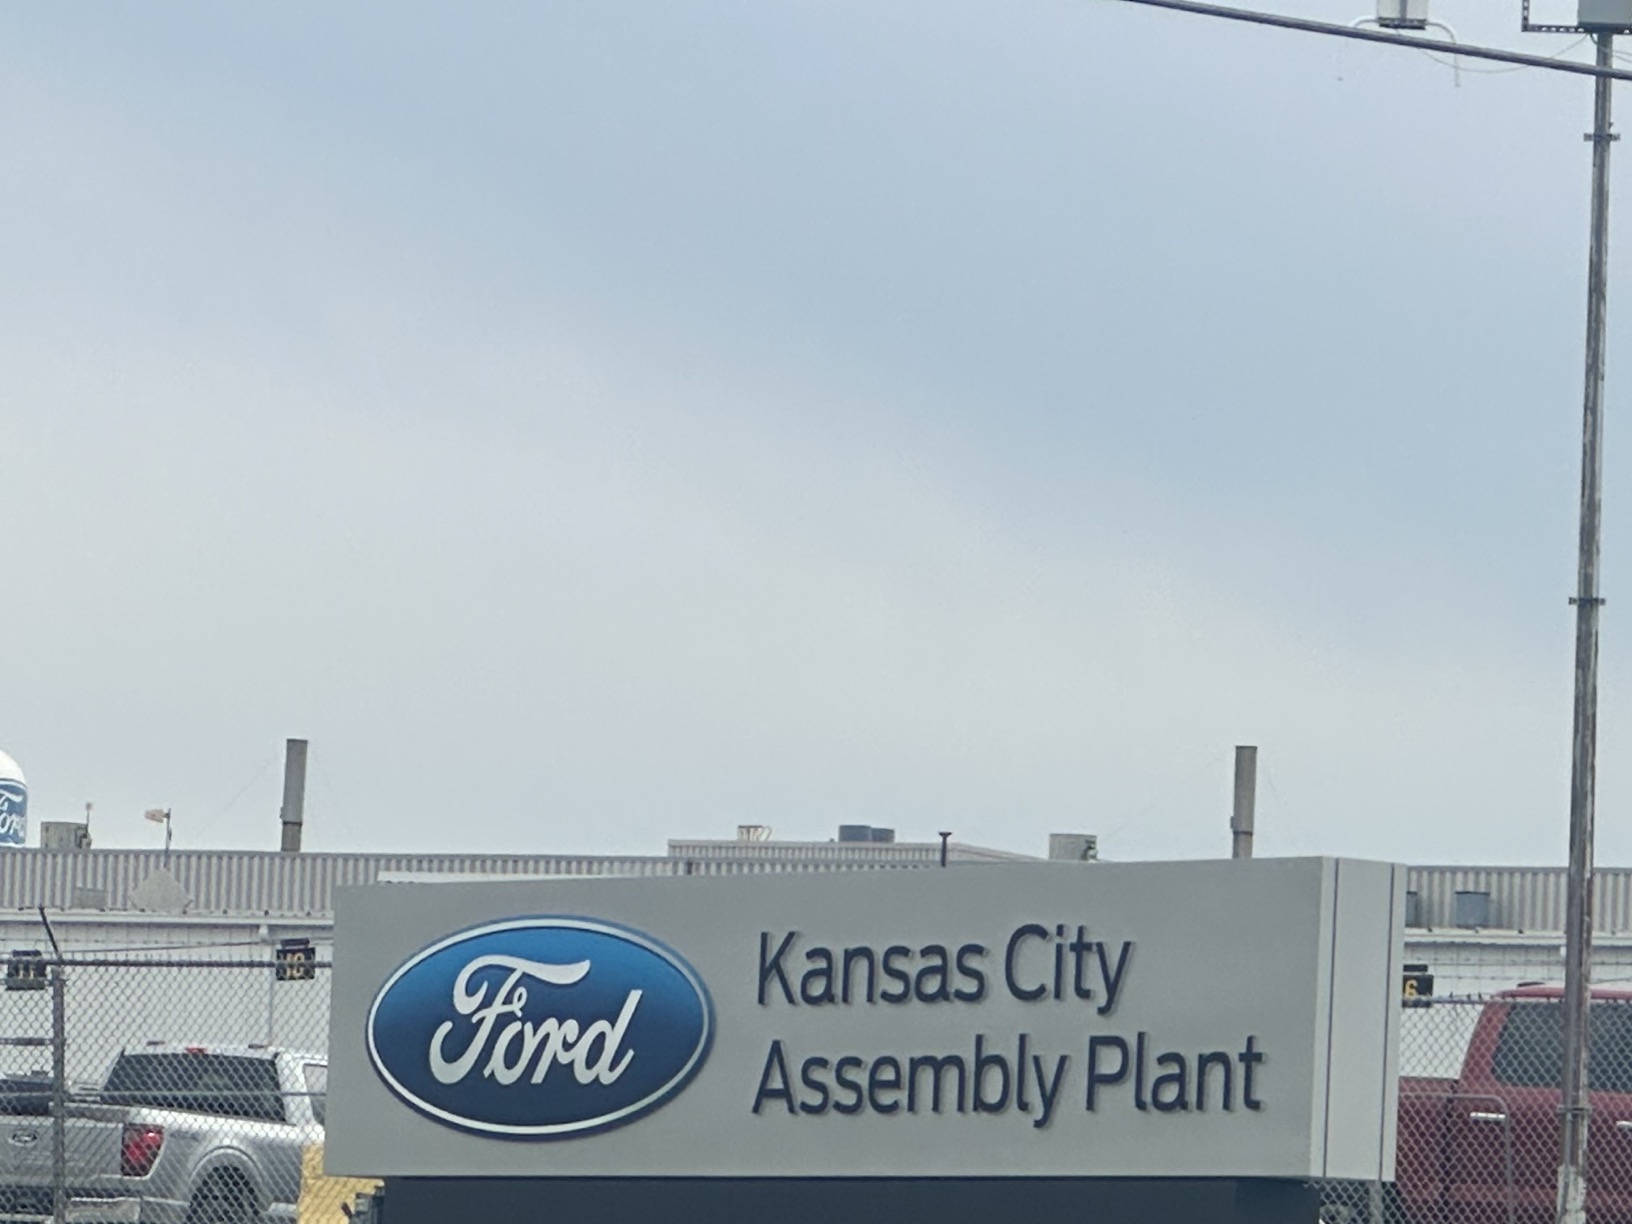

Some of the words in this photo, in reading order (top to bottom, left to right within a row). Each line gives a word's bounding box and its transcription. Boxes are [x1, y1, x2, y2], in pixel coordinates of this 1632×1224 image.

[757, 930, 986, 1005] Kansas
[1004, 923, 1131, 1014] City
[1404, 979, 1418, 1001] 6
[429, 954, 643, 1085] Ford
[751, 1033, 1068, 1129] Assembly
[1085, 1031, 1263, 1112] Plant
